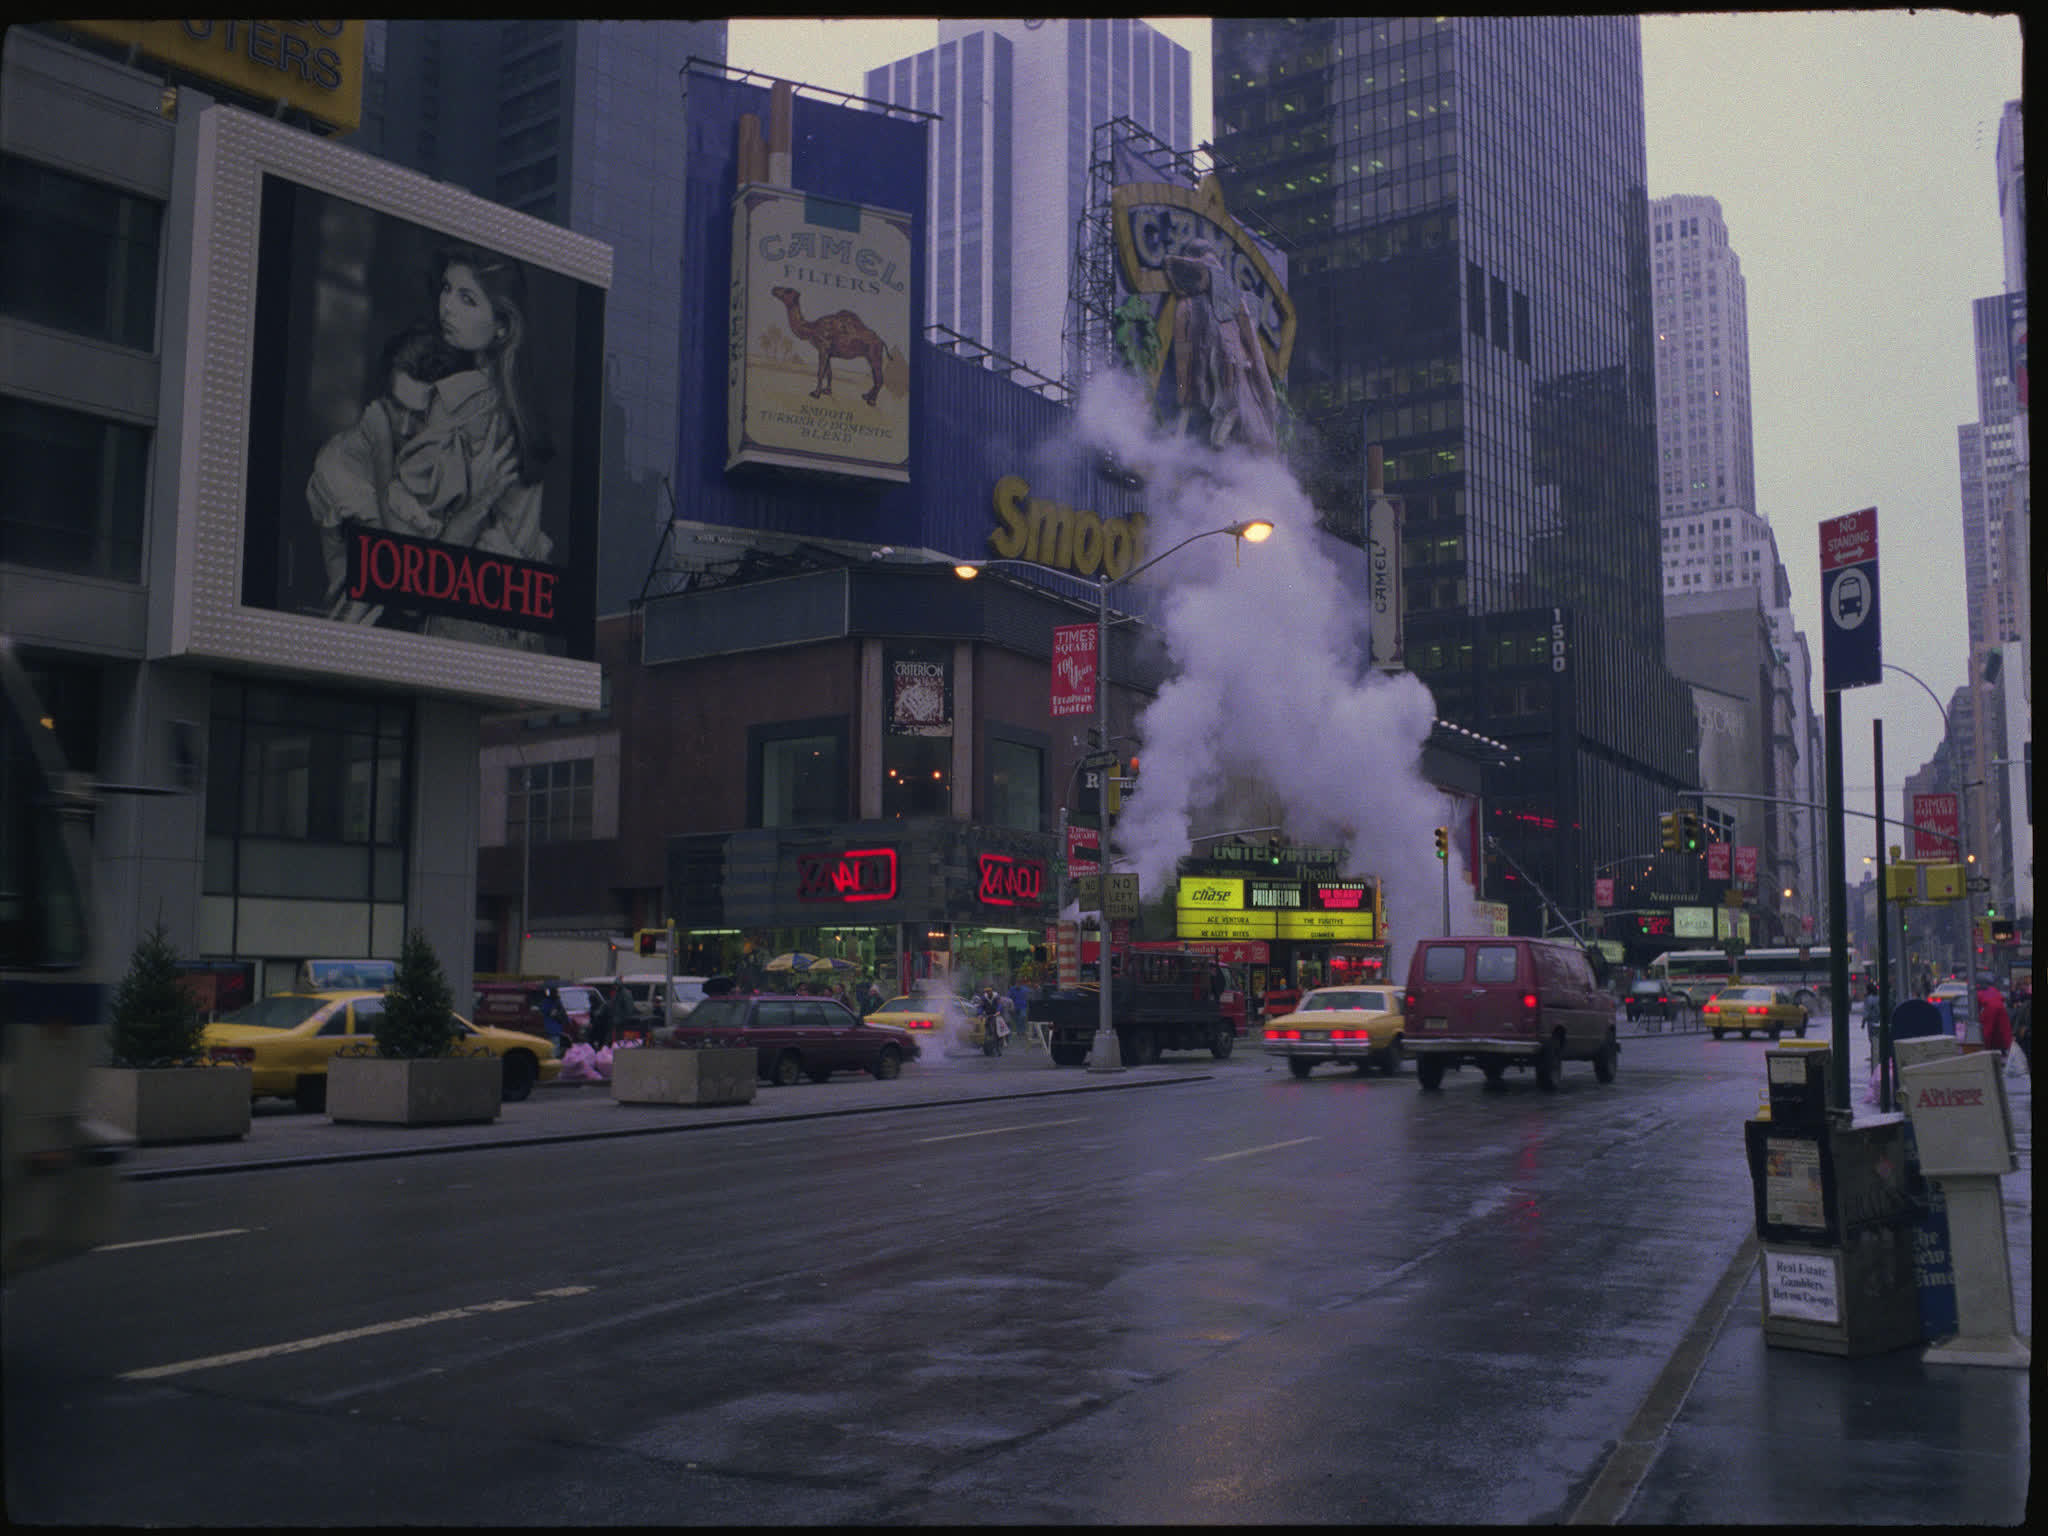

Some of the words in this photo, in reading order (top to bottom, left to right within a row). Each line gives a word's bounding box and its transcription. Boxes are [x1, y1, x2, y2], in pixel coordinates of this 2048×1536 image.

[758, 232, 904, 293] CAMEL
[783, 264, 880, 295] FILTERS
[800, 404, 854, 420] SMOOTH
[800, 428, 852, 442] BLEND
[1839, 517, 1857, 533] NO
[1827, 528, 1871, 553] STANDING
[350, 535, 556, 620] JORDACHE
[1375, 546, 1387, 614] CAMEL
[1055, 628, 1096, 642] TIMES
[1551, 607, 1567, 673] 1500
[1055, 641, 1096, 655] SQUARE
[895, 661, 944, 677] CRITERION
[1112, 878, 1132, 889] NO
[1109, 892, 1134, 902] LEFT
[1191, 889, 1232, 902] chase
[1252, 889, 1301, 907] PHILADELPHIA
[1104, 904, 1135, 914] TURN
[1776, 1260, 1796, 1273] Real
[1799, 1263, 1826, 1276] Estate
